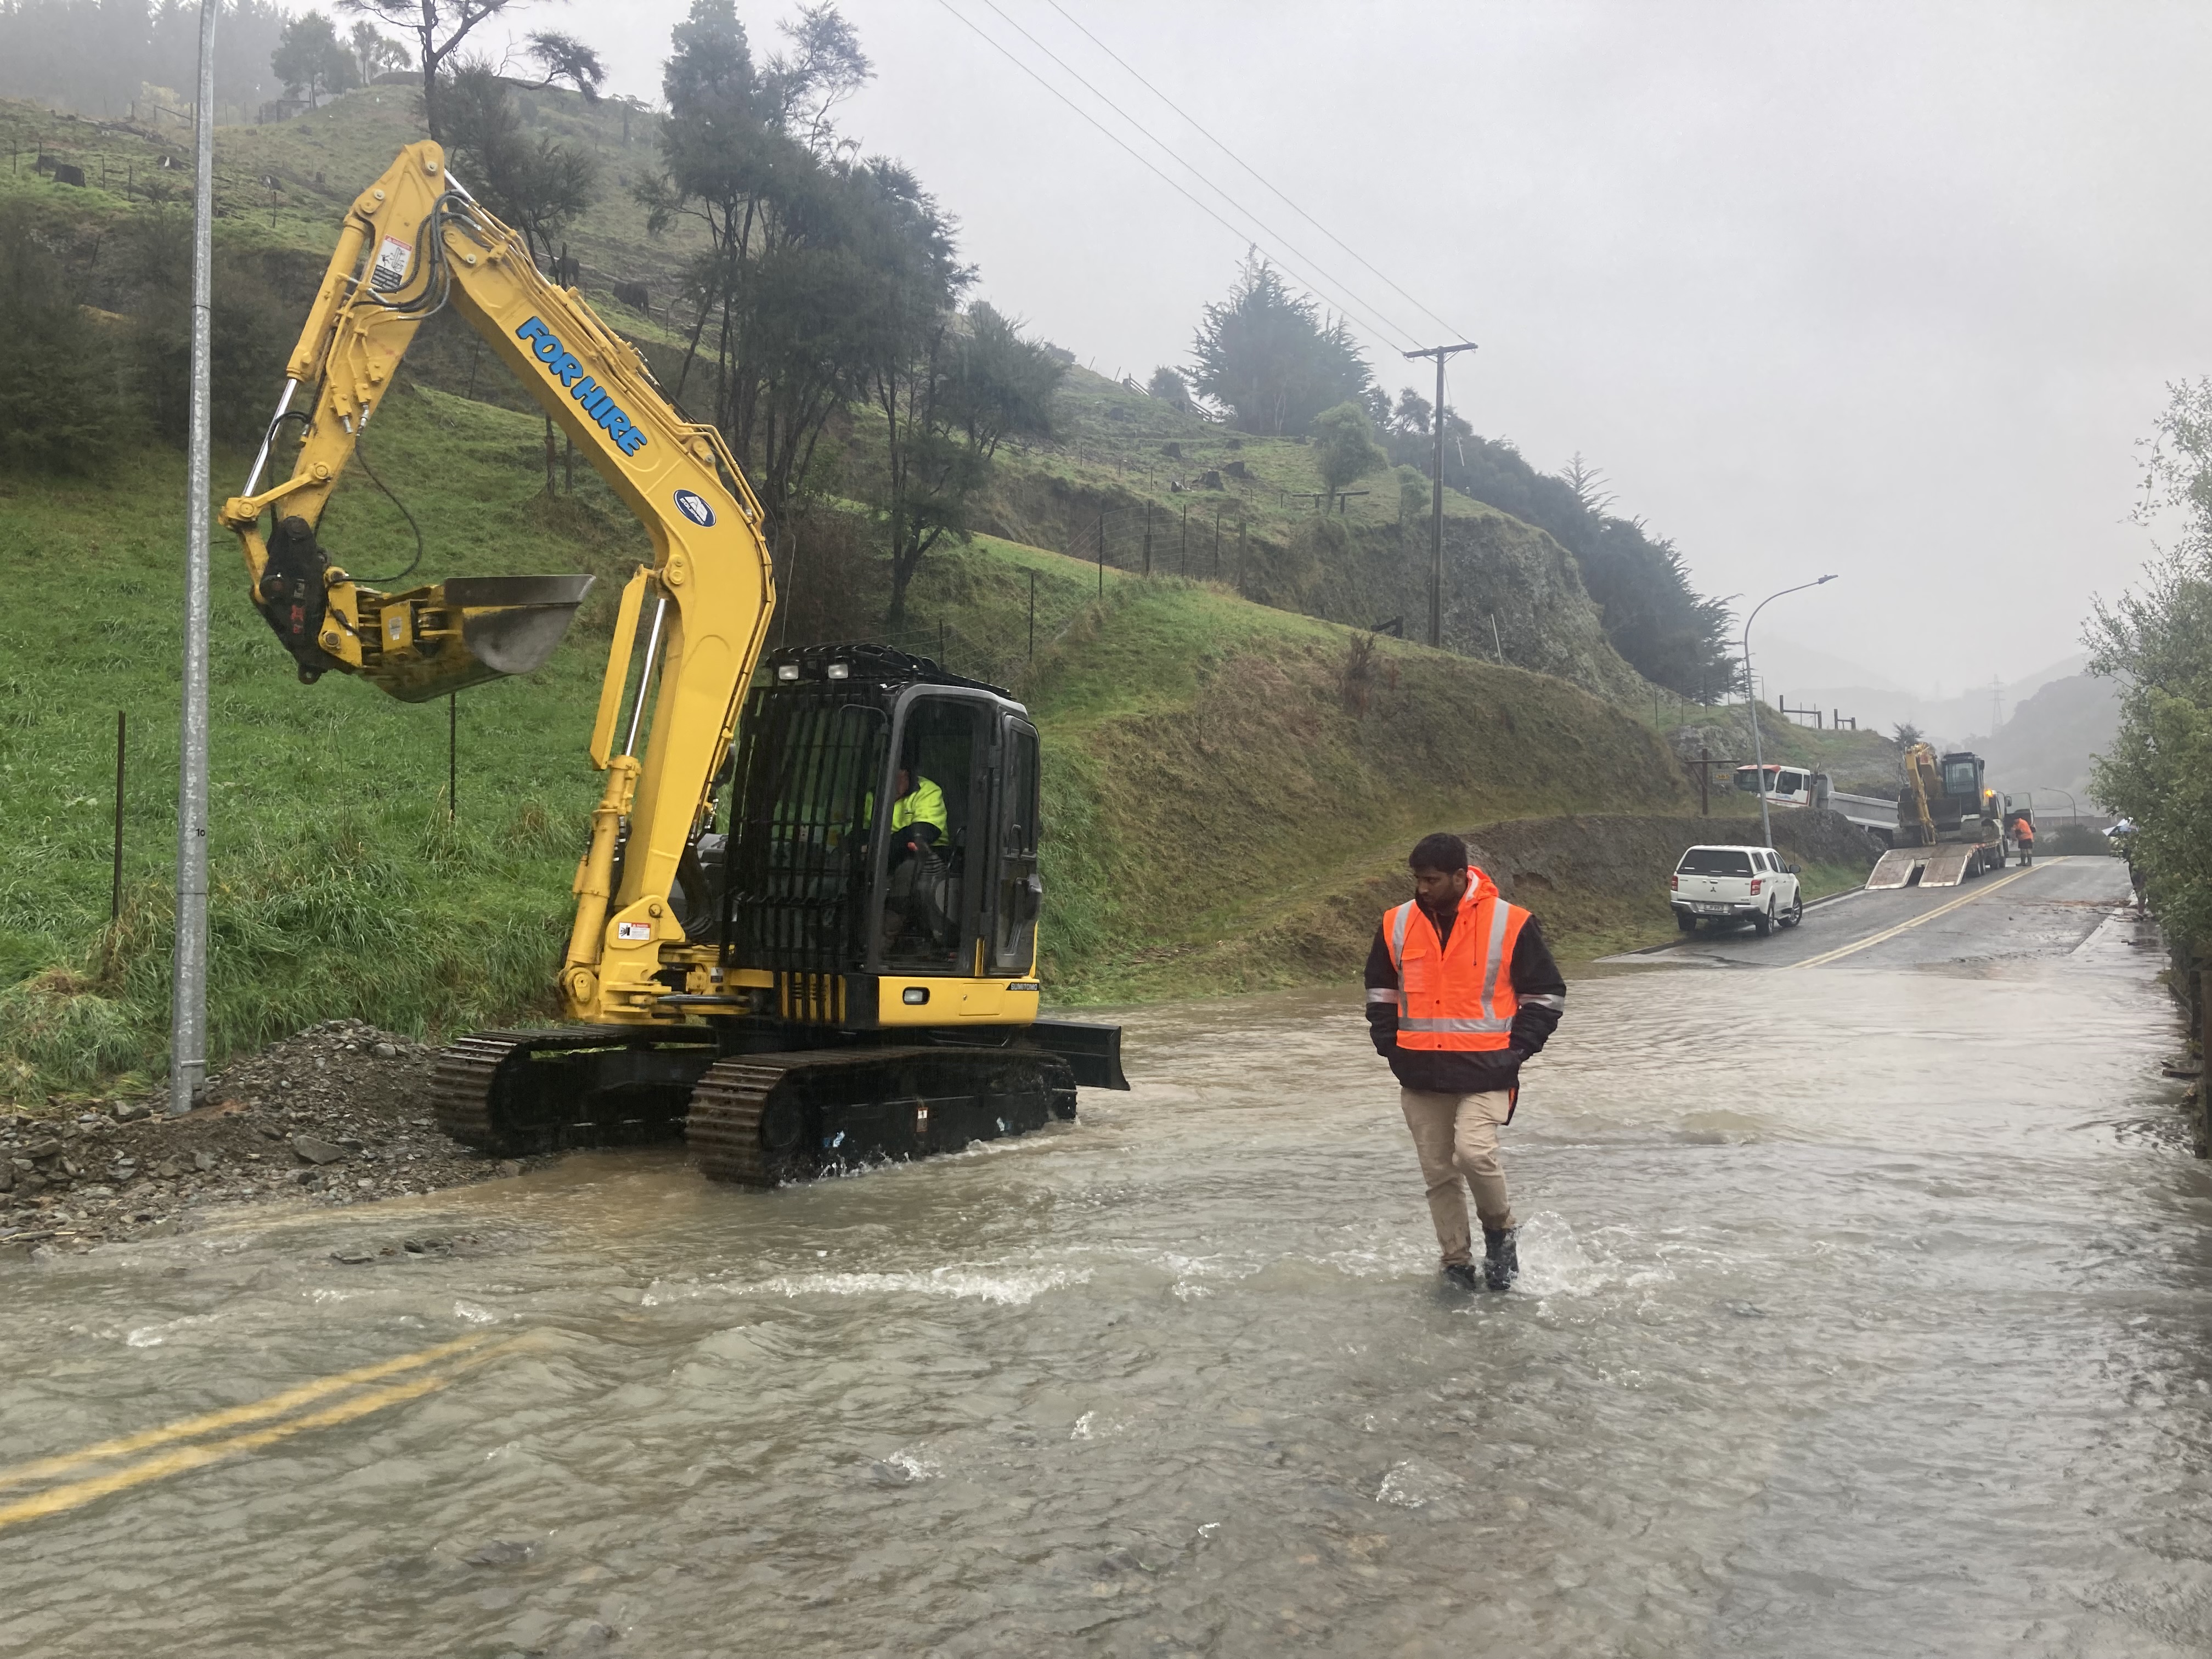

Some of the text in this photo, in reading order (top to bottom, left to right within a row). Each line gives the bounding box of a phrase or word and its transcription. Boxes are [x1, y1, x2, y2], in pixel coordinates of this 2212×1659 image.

[515, 315, 648, 457] FOR HIRE
[195, 828, 205, 837] 10
[1011, 983, 1037, 991] SUMITOMO
